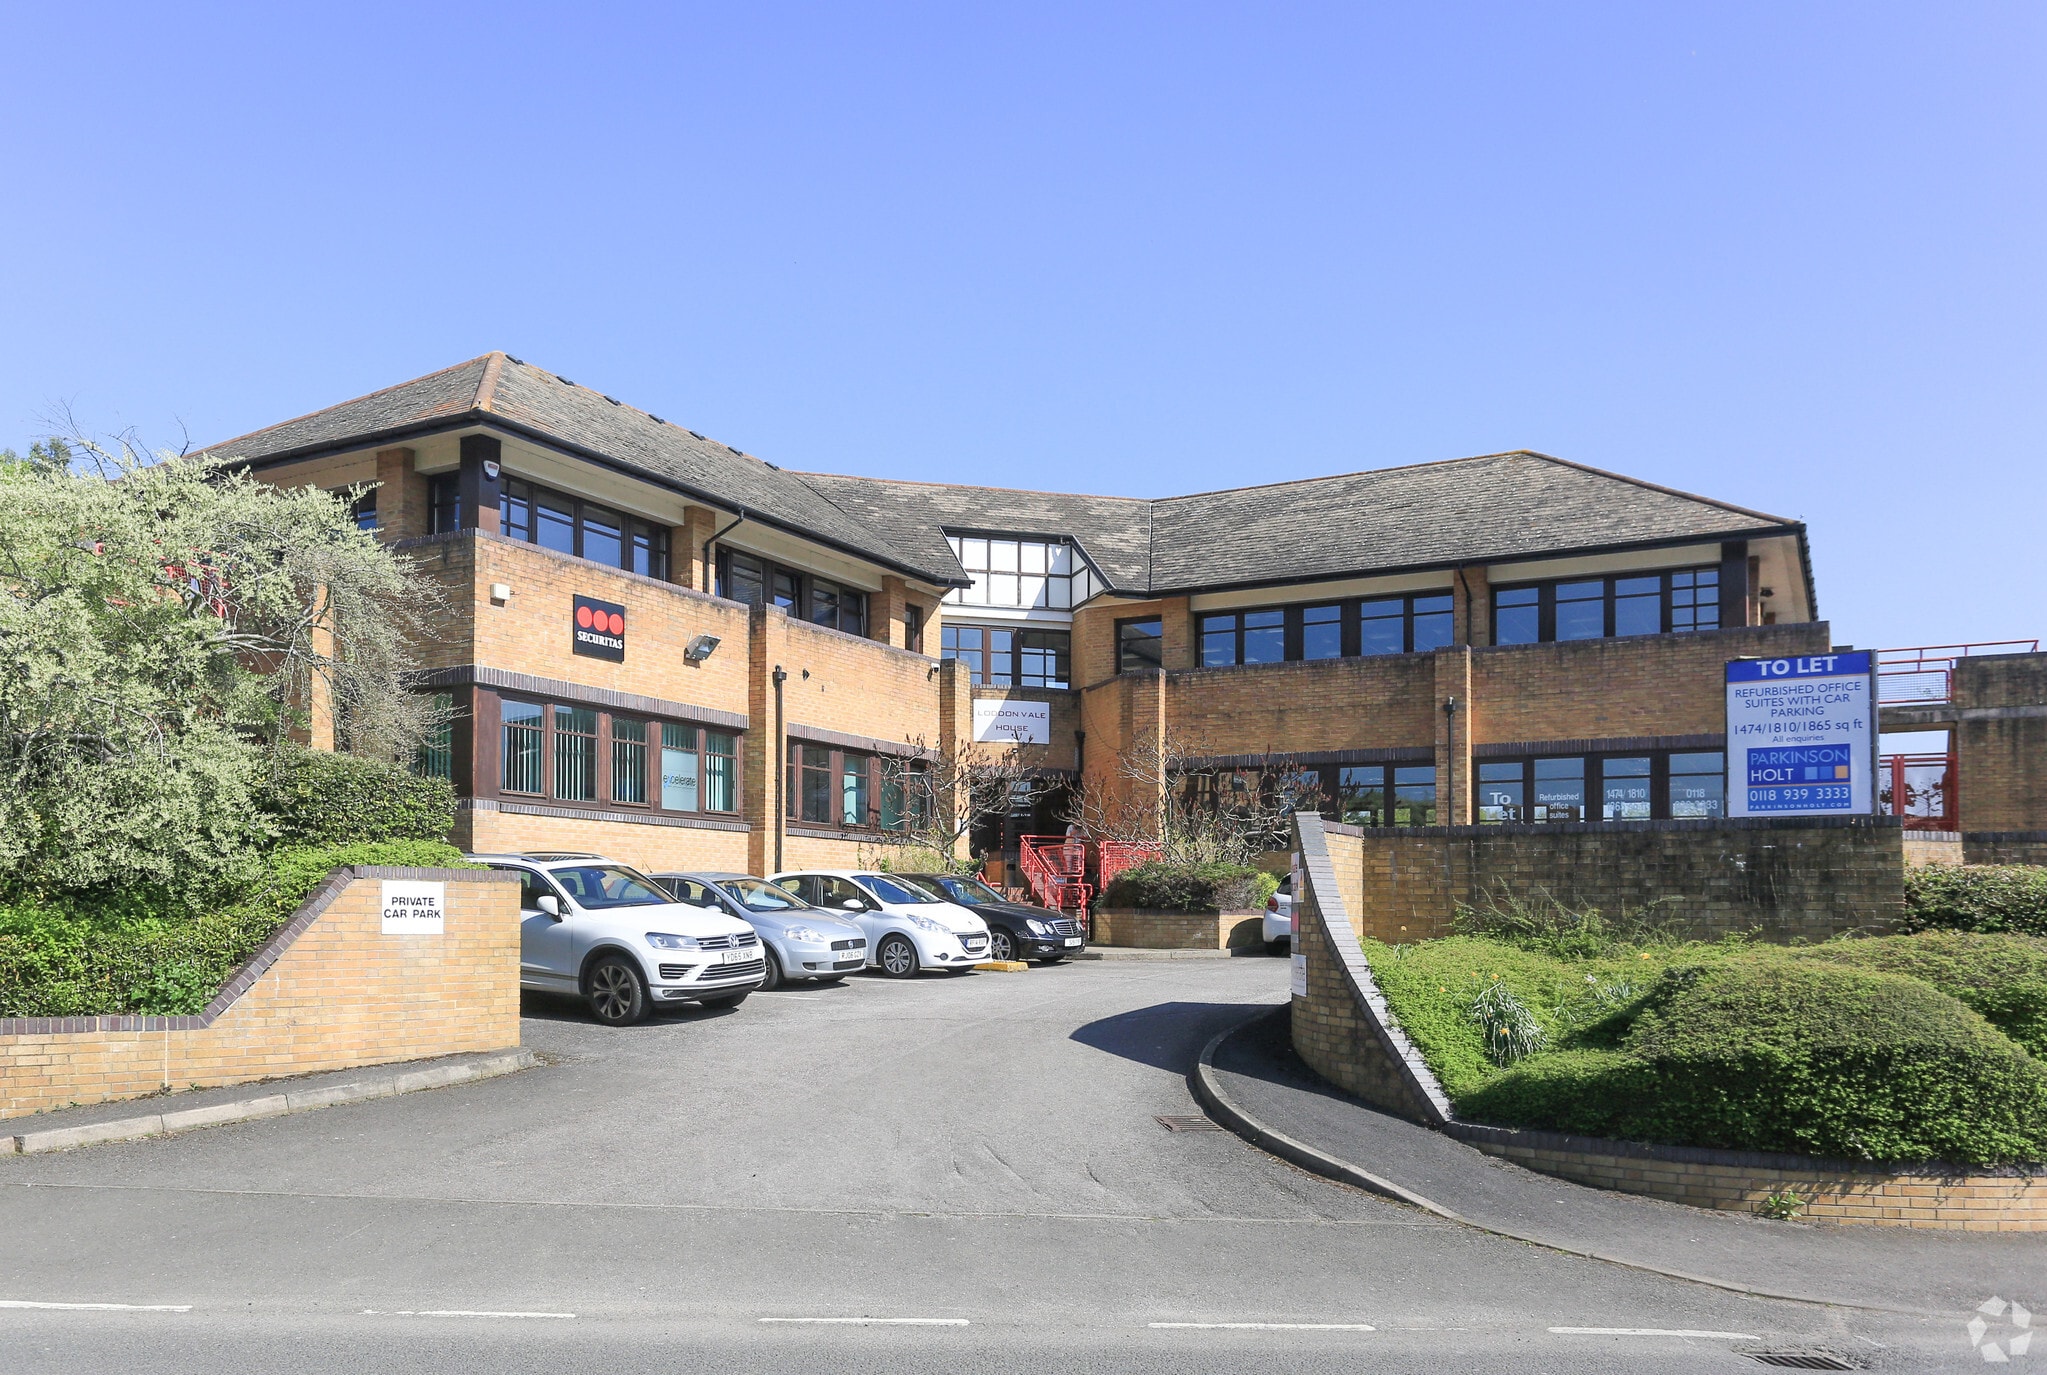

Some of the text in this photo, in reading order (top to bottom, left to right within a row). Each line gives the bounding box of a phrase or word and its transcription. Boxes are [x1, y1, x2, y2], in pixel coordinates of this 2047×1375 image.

[577, 631, 623, 650] SECURITAS
[1756, 656, 1838, 676] TO LET
[1735, 682, 1861, 698] REFURBISHED OFFICE
[1745, 694, 1850, 708] SUITES WITH CAR
[1771, 706, 1824, 717] PARKING
[1734, 719, 1863, 735] 1474/1810/1865 sq ft
[1786, 735, 1824, 743] enquiries
[1751, 749, 1848, 765] PARKINSON
[1751, 768, 1794, 782] HOLT
[1489, 792, 1512, 805] To
[1539, 792, 1579, 801] Refurbished
[1627, 788, 1645, 799] 1810
[1686, 788, 1705, 798] 0118
[1750, 787, 1849, 801] 0118 939 3333
[1750, 802, 1849, 810] PARKINSONHOLT.COM
[391, 896, 435, 906] PRIVATE
[383, 909, 441, 918] CAR PARK
